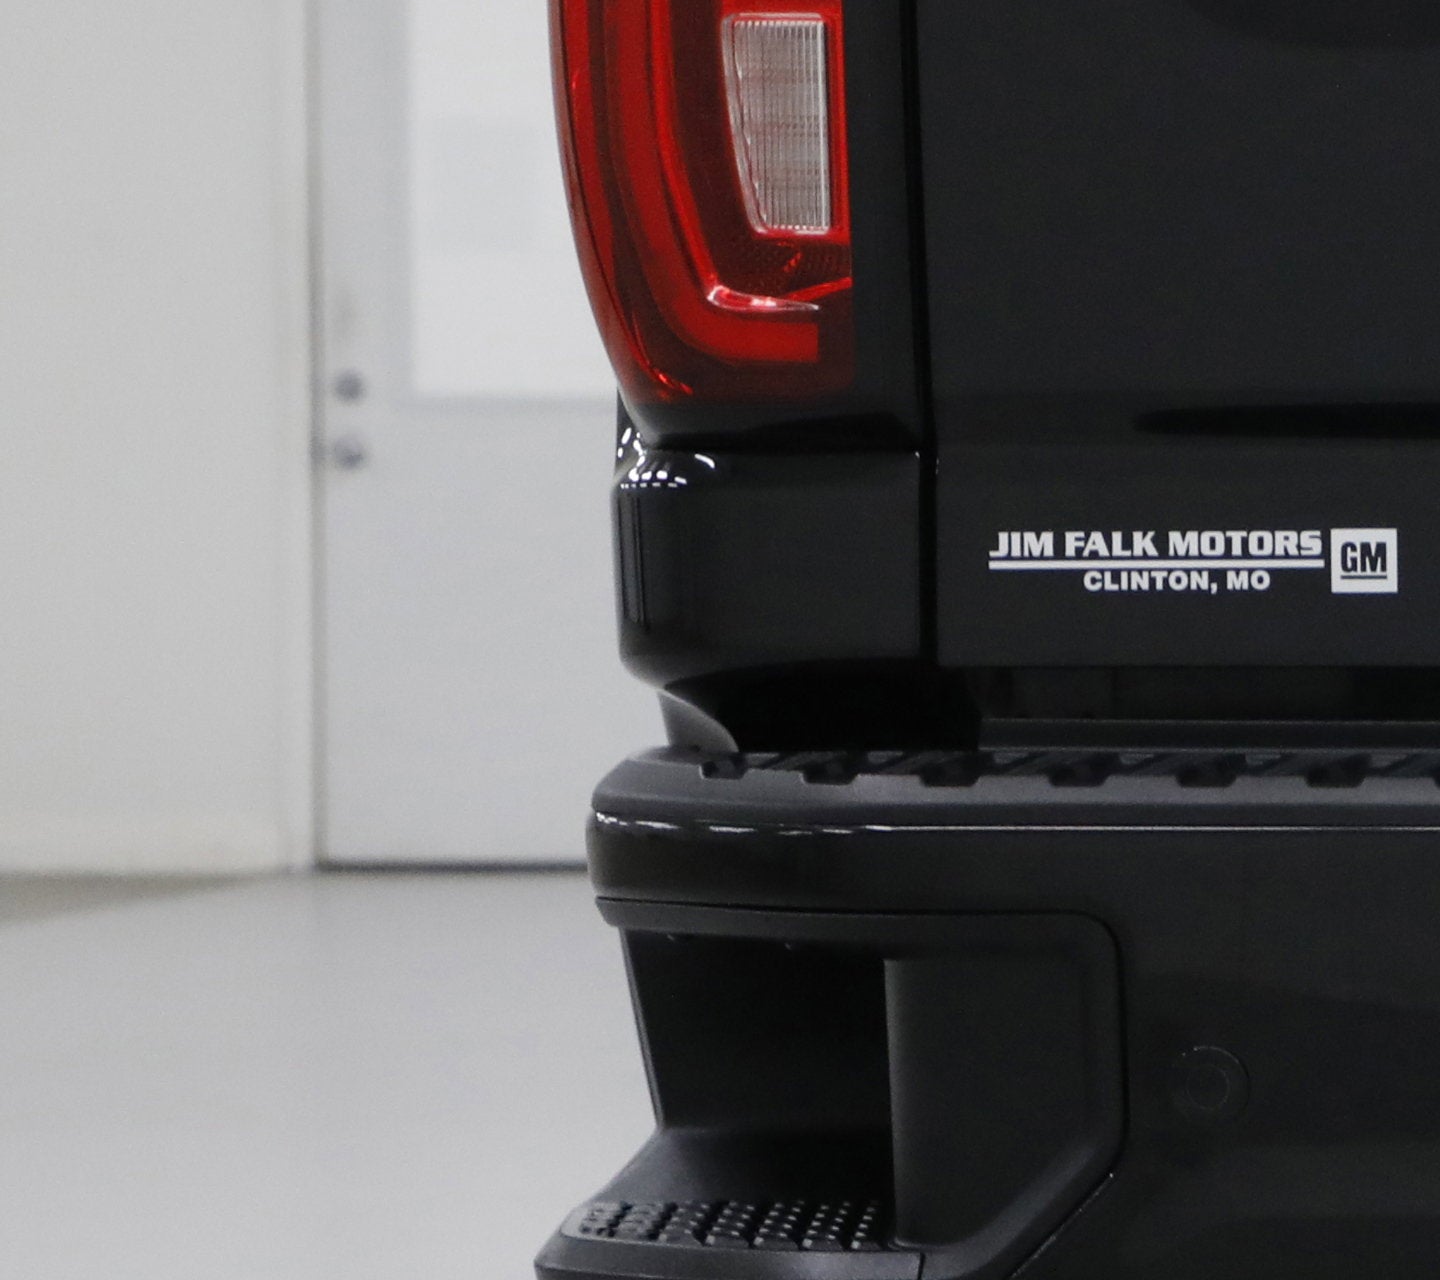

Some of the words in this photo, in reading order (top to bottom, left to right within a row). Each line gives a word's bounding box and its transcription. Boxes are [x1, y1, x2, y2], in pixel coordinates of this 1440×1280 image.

[989, 531, 1055, 558] JIM
[1064, 531, 1159, 557] FALK
[1167, 530, 1322, 557] MOTORS
[1340, 541, 1387, 574] GM
[1083, 570, 1218, 594] CLINTON,
[1226, 570, 1270, 591] MO
